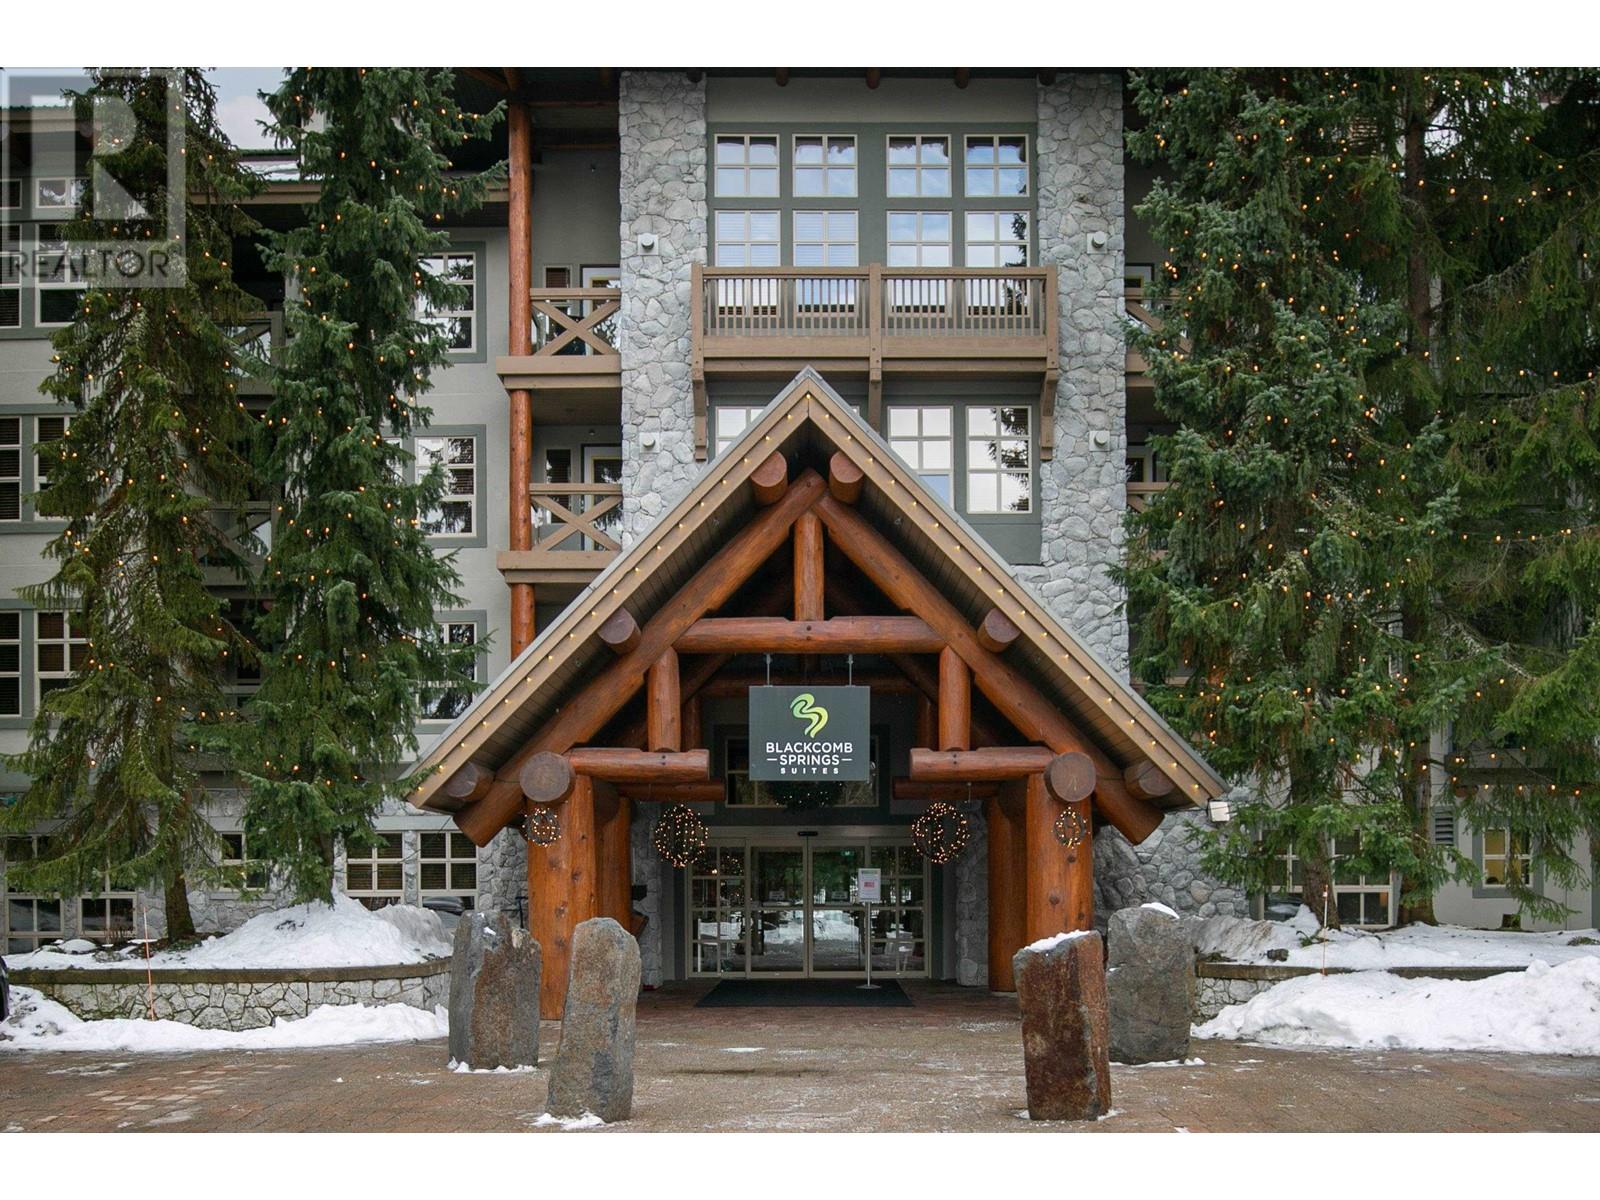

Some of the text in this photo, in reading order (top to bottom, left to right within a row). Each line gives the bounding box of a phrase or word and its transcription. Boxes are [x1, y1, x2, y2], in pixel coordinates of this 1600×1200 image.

[765, 742, 853, 754] BLACKCOMB
[779, 754, 840, 766] SPRINGS
[780, 767, 839, 775] SUITES
